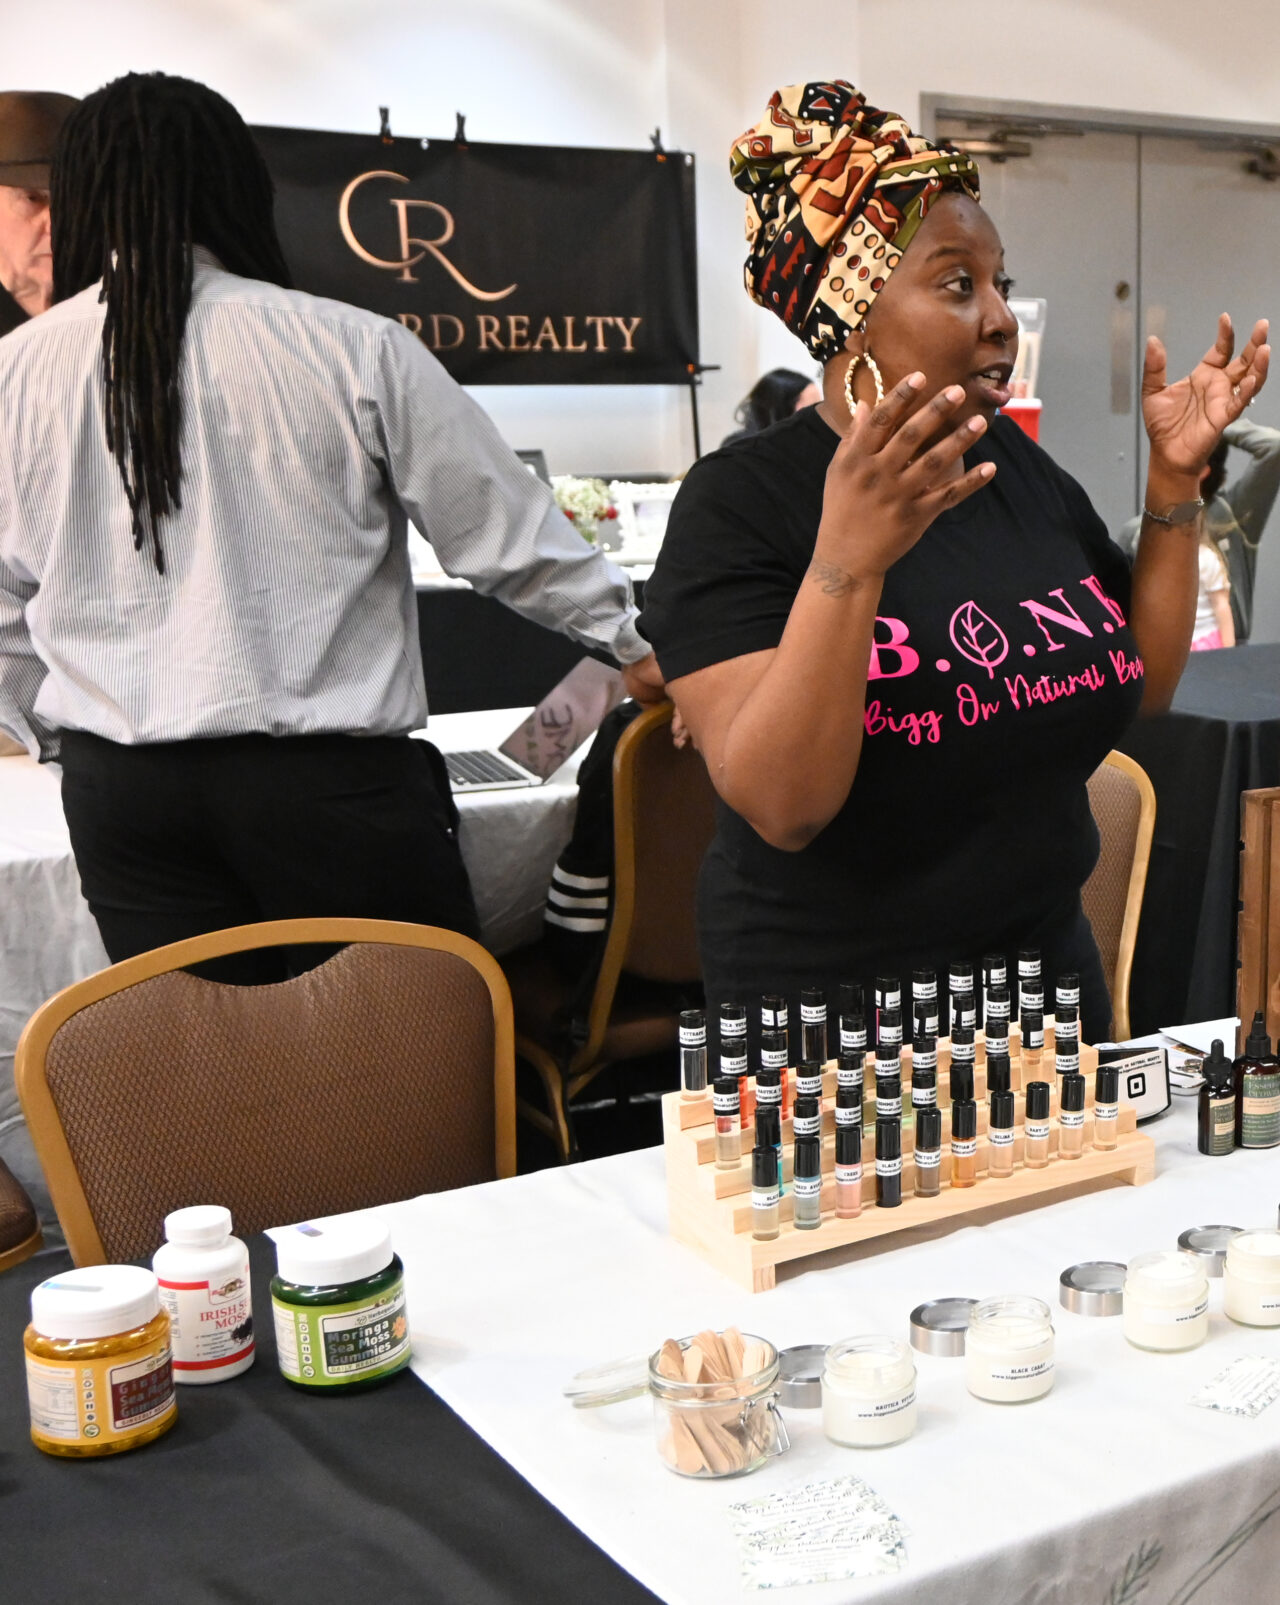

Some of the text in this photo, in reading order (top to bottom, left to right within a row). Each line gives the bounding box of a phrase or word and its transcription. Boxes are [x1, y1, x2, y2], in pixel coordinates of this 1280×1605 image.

[477, 315, 642, 352] REALTY
[864, 700, 943, 745] Bigg
[956, 683, 1000, 726] On
[1004, 664, 1105, 710] Natural
[200, 1304, 237, 1322] IRISH
[327, 1320, 389, 1343] Moringa
[328, 1330, 390, 1354] Sea Moss
[329, 1342, 391, 1365] Gummies
[331, 1364, 353, 1372] DAILY
[875, 1402, 900, 1410] NAUTICA
